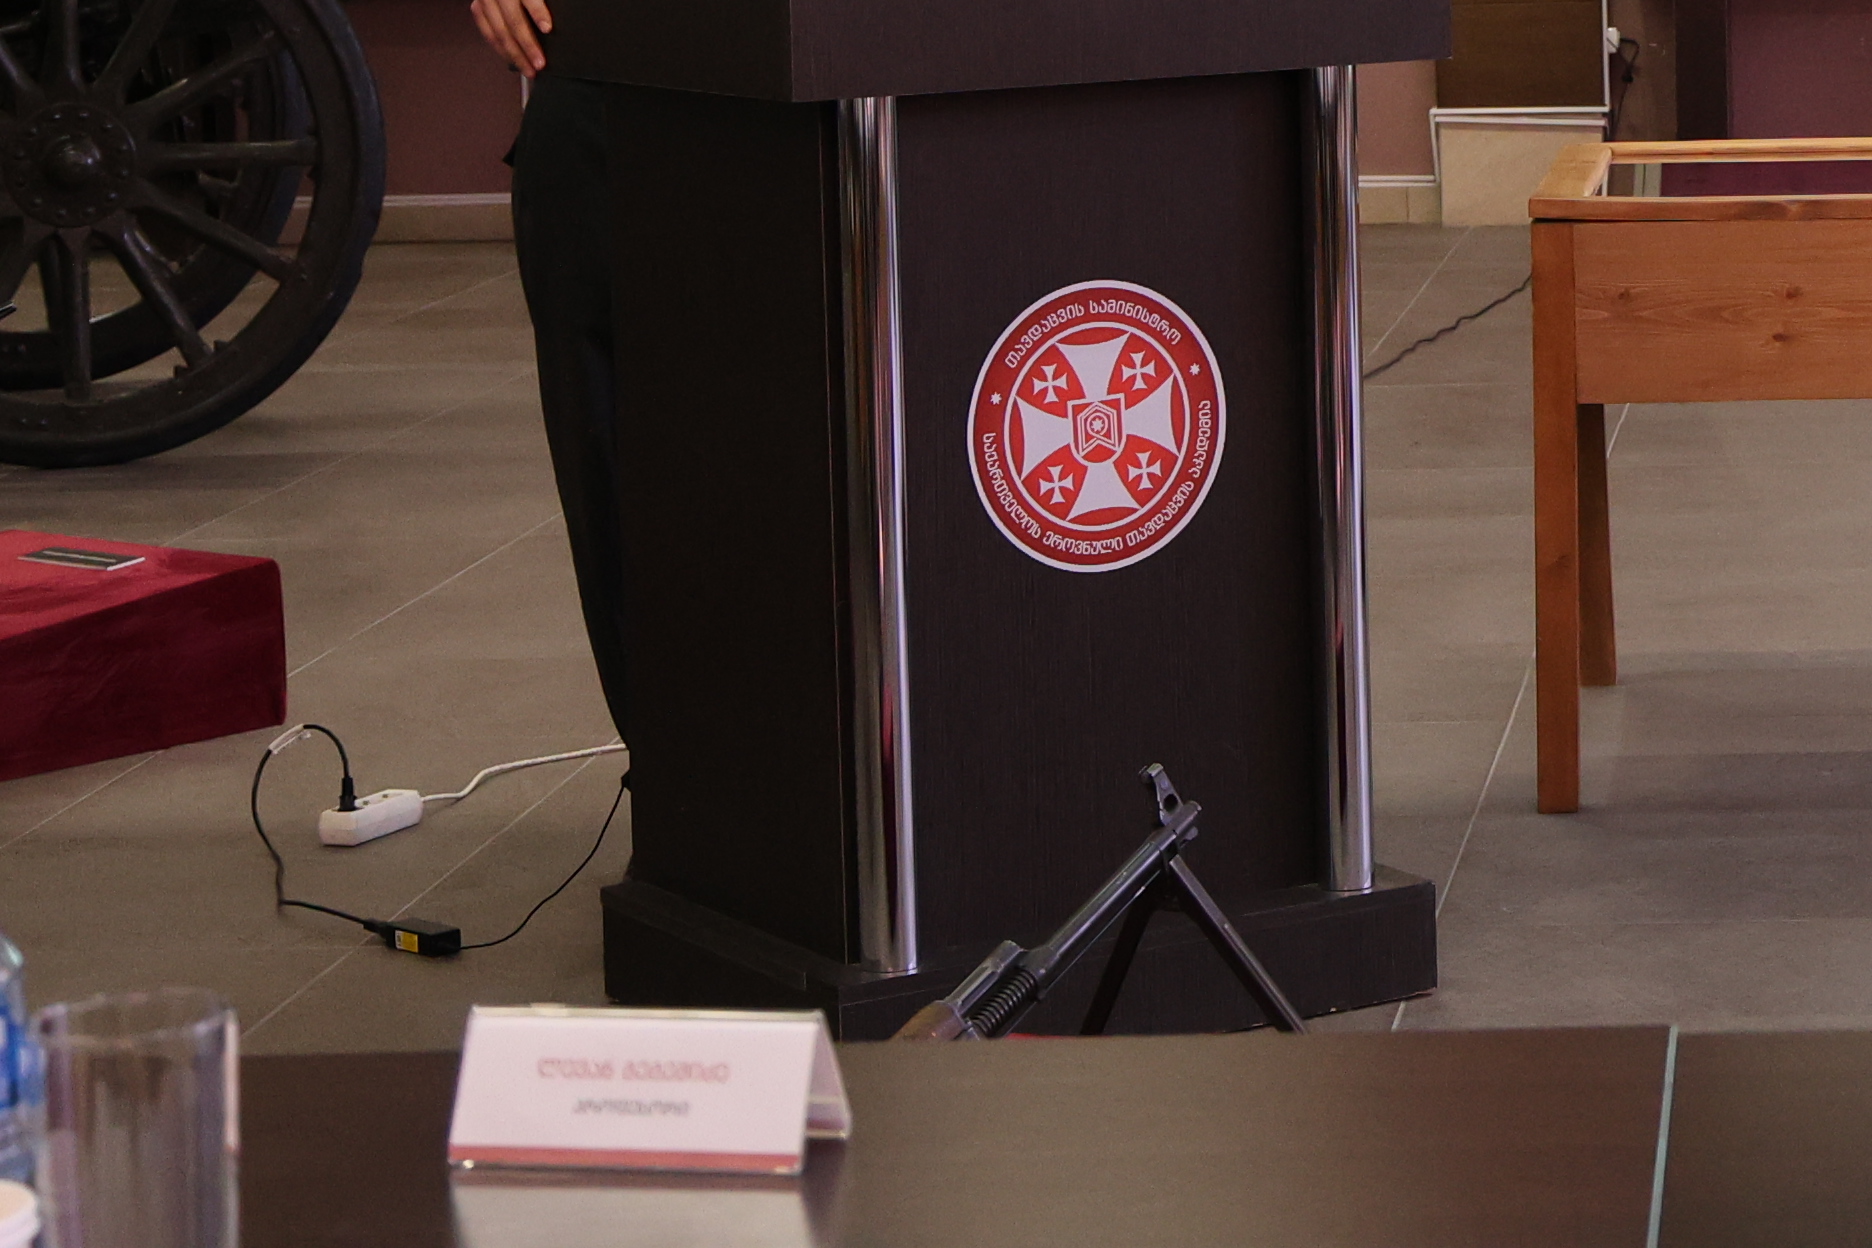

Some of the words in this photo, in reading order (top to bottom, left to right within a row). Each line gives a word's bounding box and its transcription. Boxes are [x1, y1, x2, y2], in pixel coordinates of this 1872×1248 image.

[1004, 302, 1085, 370] თავდაცვის
[1090, 298, 1183, 346] სამინისტრო
[982, 432, 1041, 539] საქართველოს
[1043, 529, 1124, 555] ეროვნული
[1126, 481, 1194, 548] თავდაცვის
[1189, 399, 1212, 481] აკადემია
